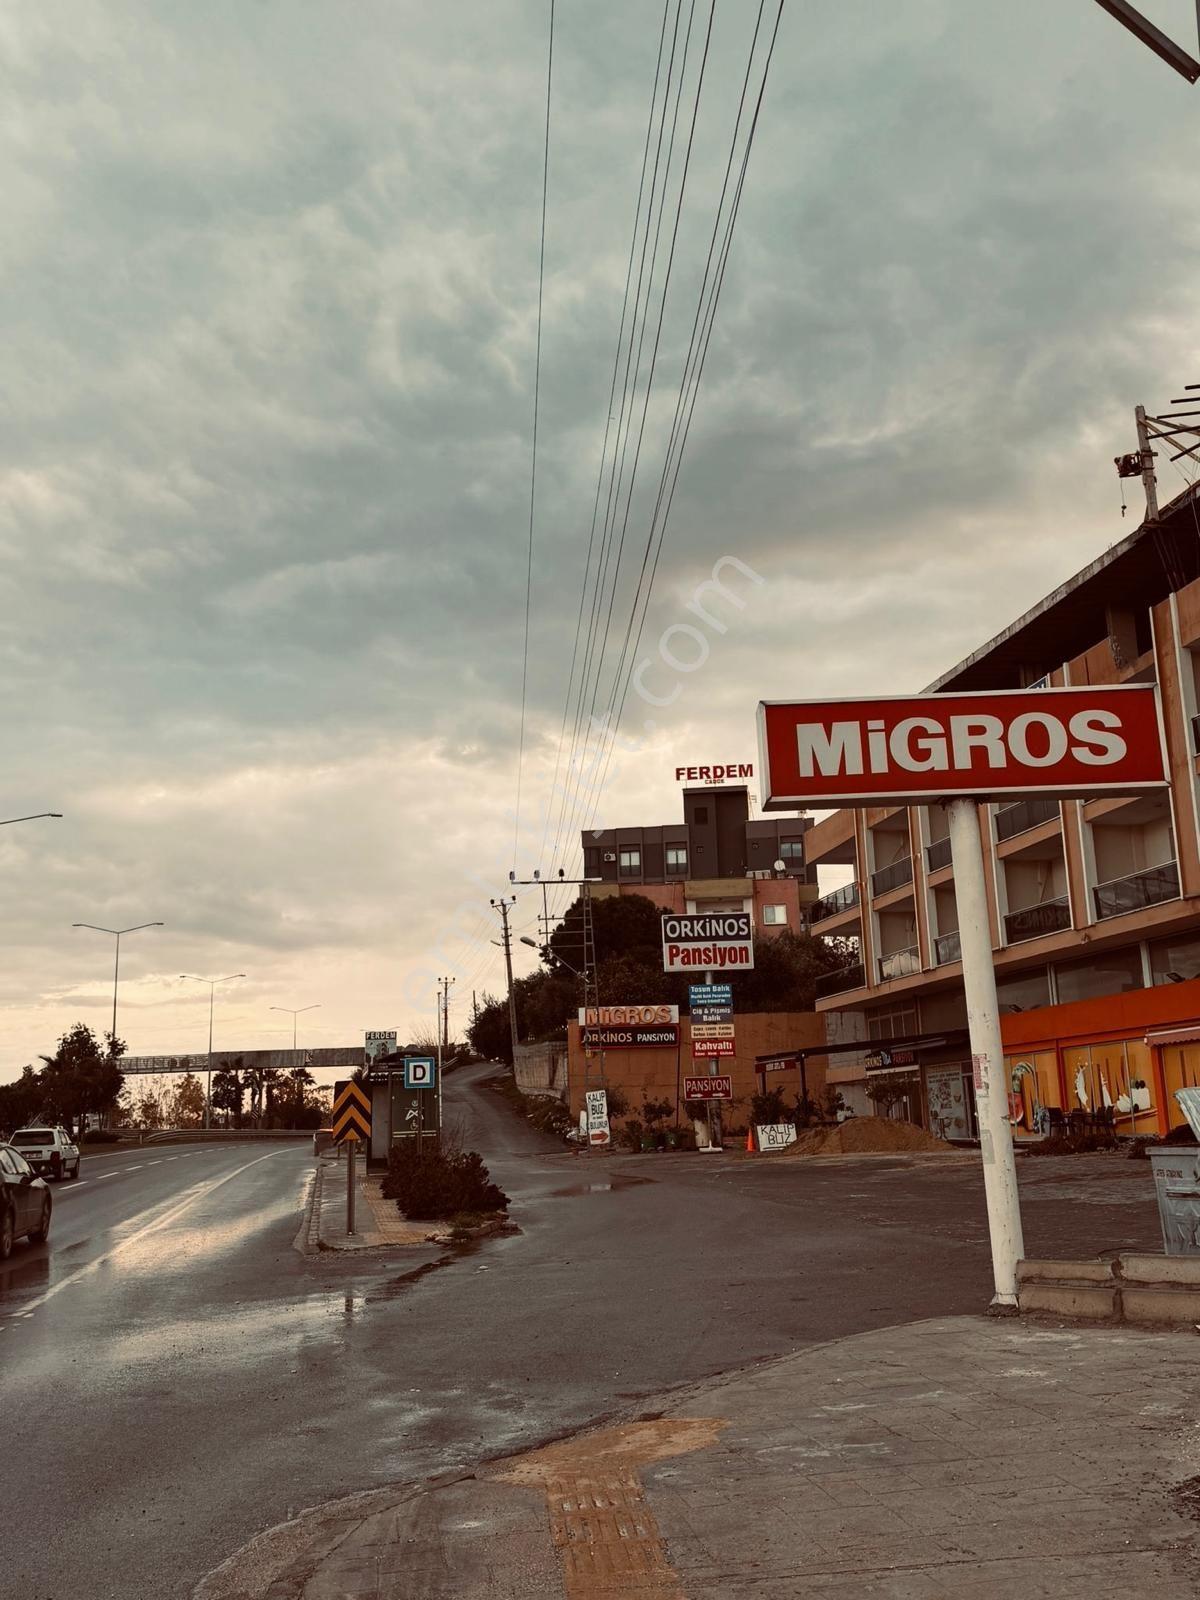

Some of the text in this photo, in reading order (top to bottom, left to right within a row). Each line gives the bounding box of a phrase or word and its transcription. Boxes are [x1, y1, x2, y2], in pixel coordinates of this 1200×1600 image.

[675, 763, 754, 781] FERDEM
[668, 943, 750, 968] Pansiyon
[366, 1031, 396, 1039] FERDEM
[695, 1041, 732, 1050] Kahvaltı
[413, 1064, 426, 1081] D
[591, 1104, 605, 1115] BUZ
[760, 1124, 795, 1135] KALIP
[767, 1133, 793, 1145] BUZ
